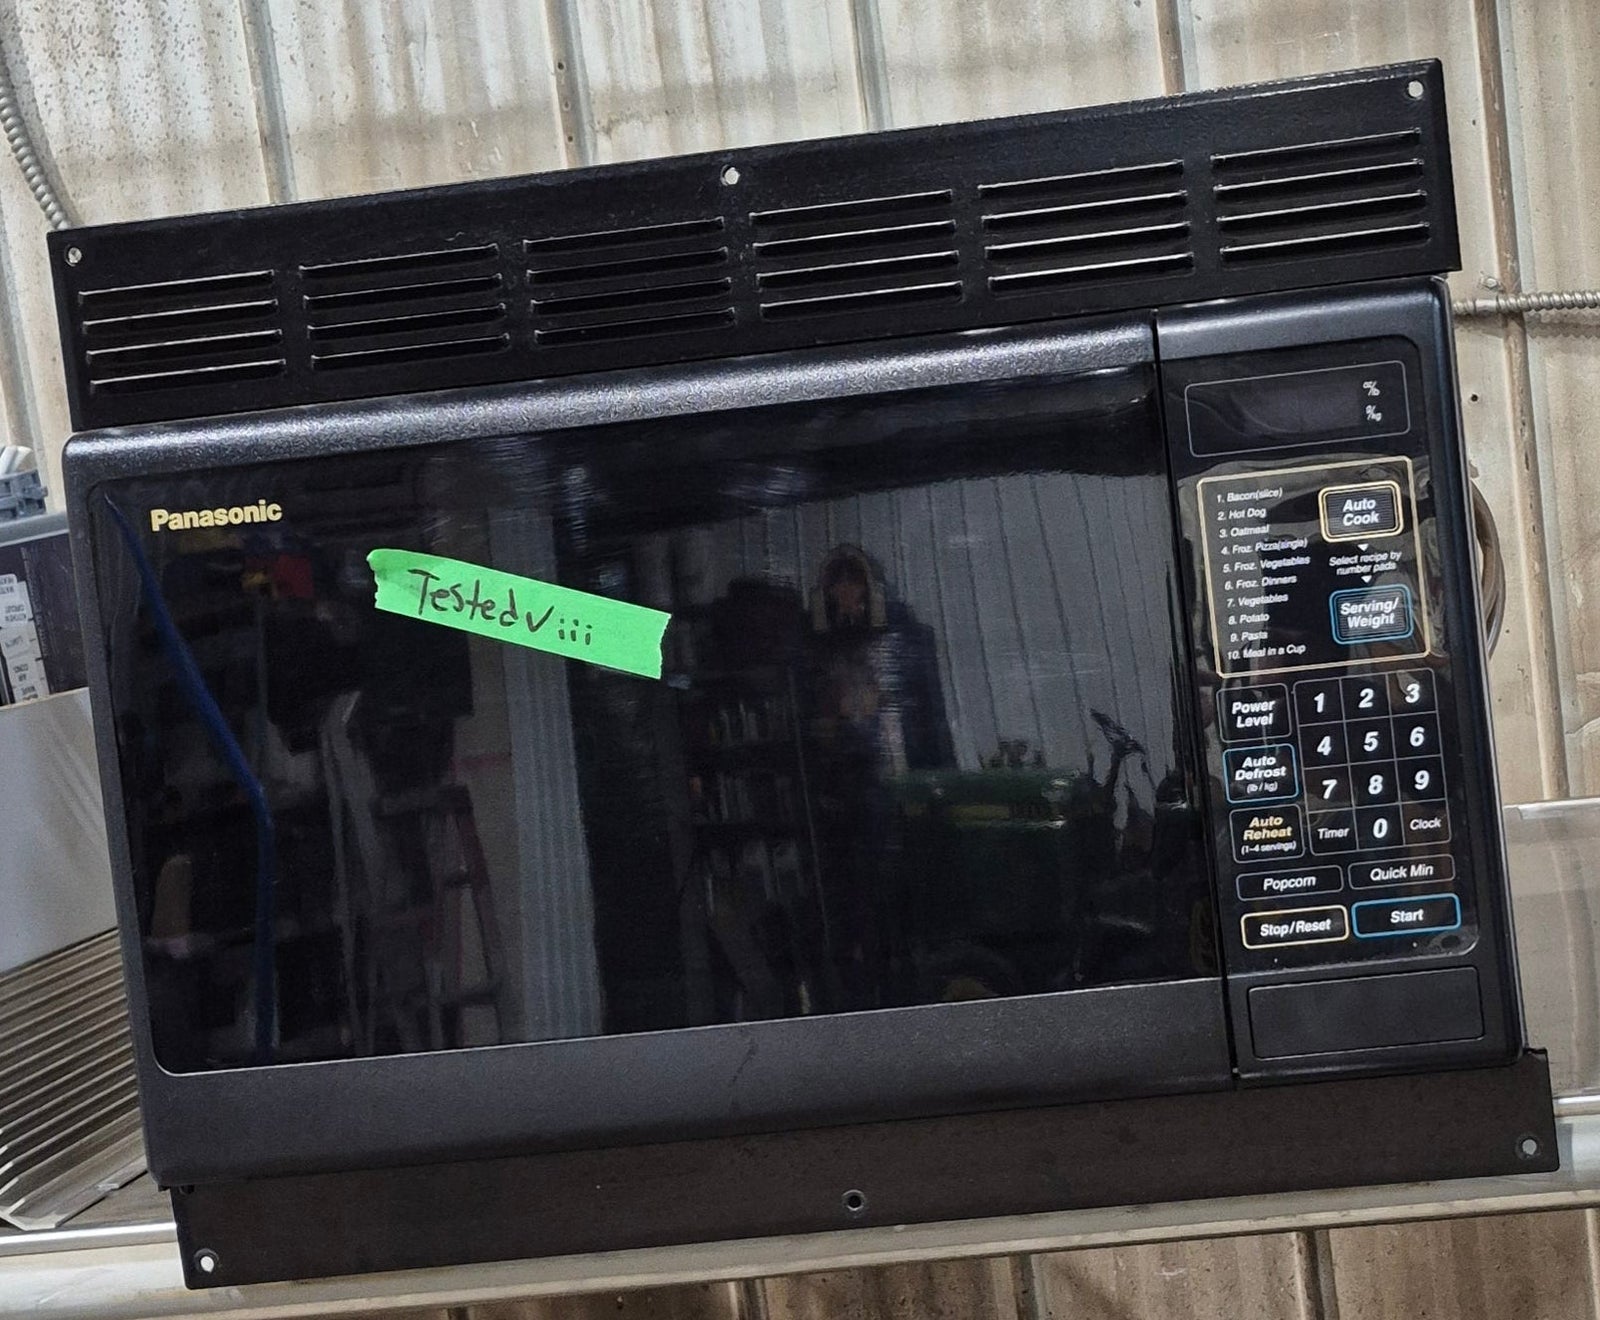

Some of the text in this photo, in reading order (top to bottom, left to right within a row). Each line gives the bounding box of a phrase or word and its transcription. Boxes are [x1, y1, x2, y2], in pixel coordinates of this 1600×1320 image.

[1217, 487, 1283, 503] 1. Bacon(slice)
[1343, 498, 1376, 512] Auto
[150, 499, 282, 532] Panasonic
[1217, 507, 1267, 521] 2. Hot Dog
[1343, 510, 1380, 526] Cook
[1219, 524, 1270, 538] 3. Oatmeal
[1221, 546, 1230, 555] 4.
[1329, 550, 1402, 567] Select recipe by
[1223, 556, 1311, 573] 5. Froz. Vegetables
[1337, 561, 1397, 575] number pads
[1225, 575, 1297, 590] 6. Froz. Dinners
[407, 569, 518, 627] Tested
[1227, 594, 1289, 608] 7. Vegetables
[1340, 597, 1399, 616] Serving/
[1228, 613, 1270, 625] 8. Potato
[1347, 612, 1395, 629] Weight
[1241, 631, 1268, 641] Pasta
[1228, 644, 1306, 660] 10. Meal in a Cup
[1358, 688, 1374, 708] 2
[1405, 683, 1420, 703] 3
[1231, 700, 1276, 715] Power
[1314, 693, 1324, 713] 1
[1236, 713, 1273, 728] Level
[1363, 731, 1379, 751] 5
[1409, 726, 1425, 747] 6
[1317, 736, 1331, 756] 4
[1242, 756, 1276, 768] Auto
[1235, 766, 1287, 781] Defrost
[1414, 770, 1430, 790] 9
[1322, 779, 1337, 799] 7
[1368, 774, 1383, 795] 8
[1249, 816, 1283, 828] Auto
[1372, 817, 1388, 838] 0
[1409, 817, 1442, 831] Clock
[1243, 826, 1292, 841] Reheat
[1318, 826, 1350, 840] Timer
[1260, 841, 1297, 853] servings)
[1370, 864, 1434, 882] Quick Min
[1263, 874, 1316, 891] Popcorn
[1390, 909, 1424, 924] Start
[1260, 919, 1331, 938] Stop/Reset
